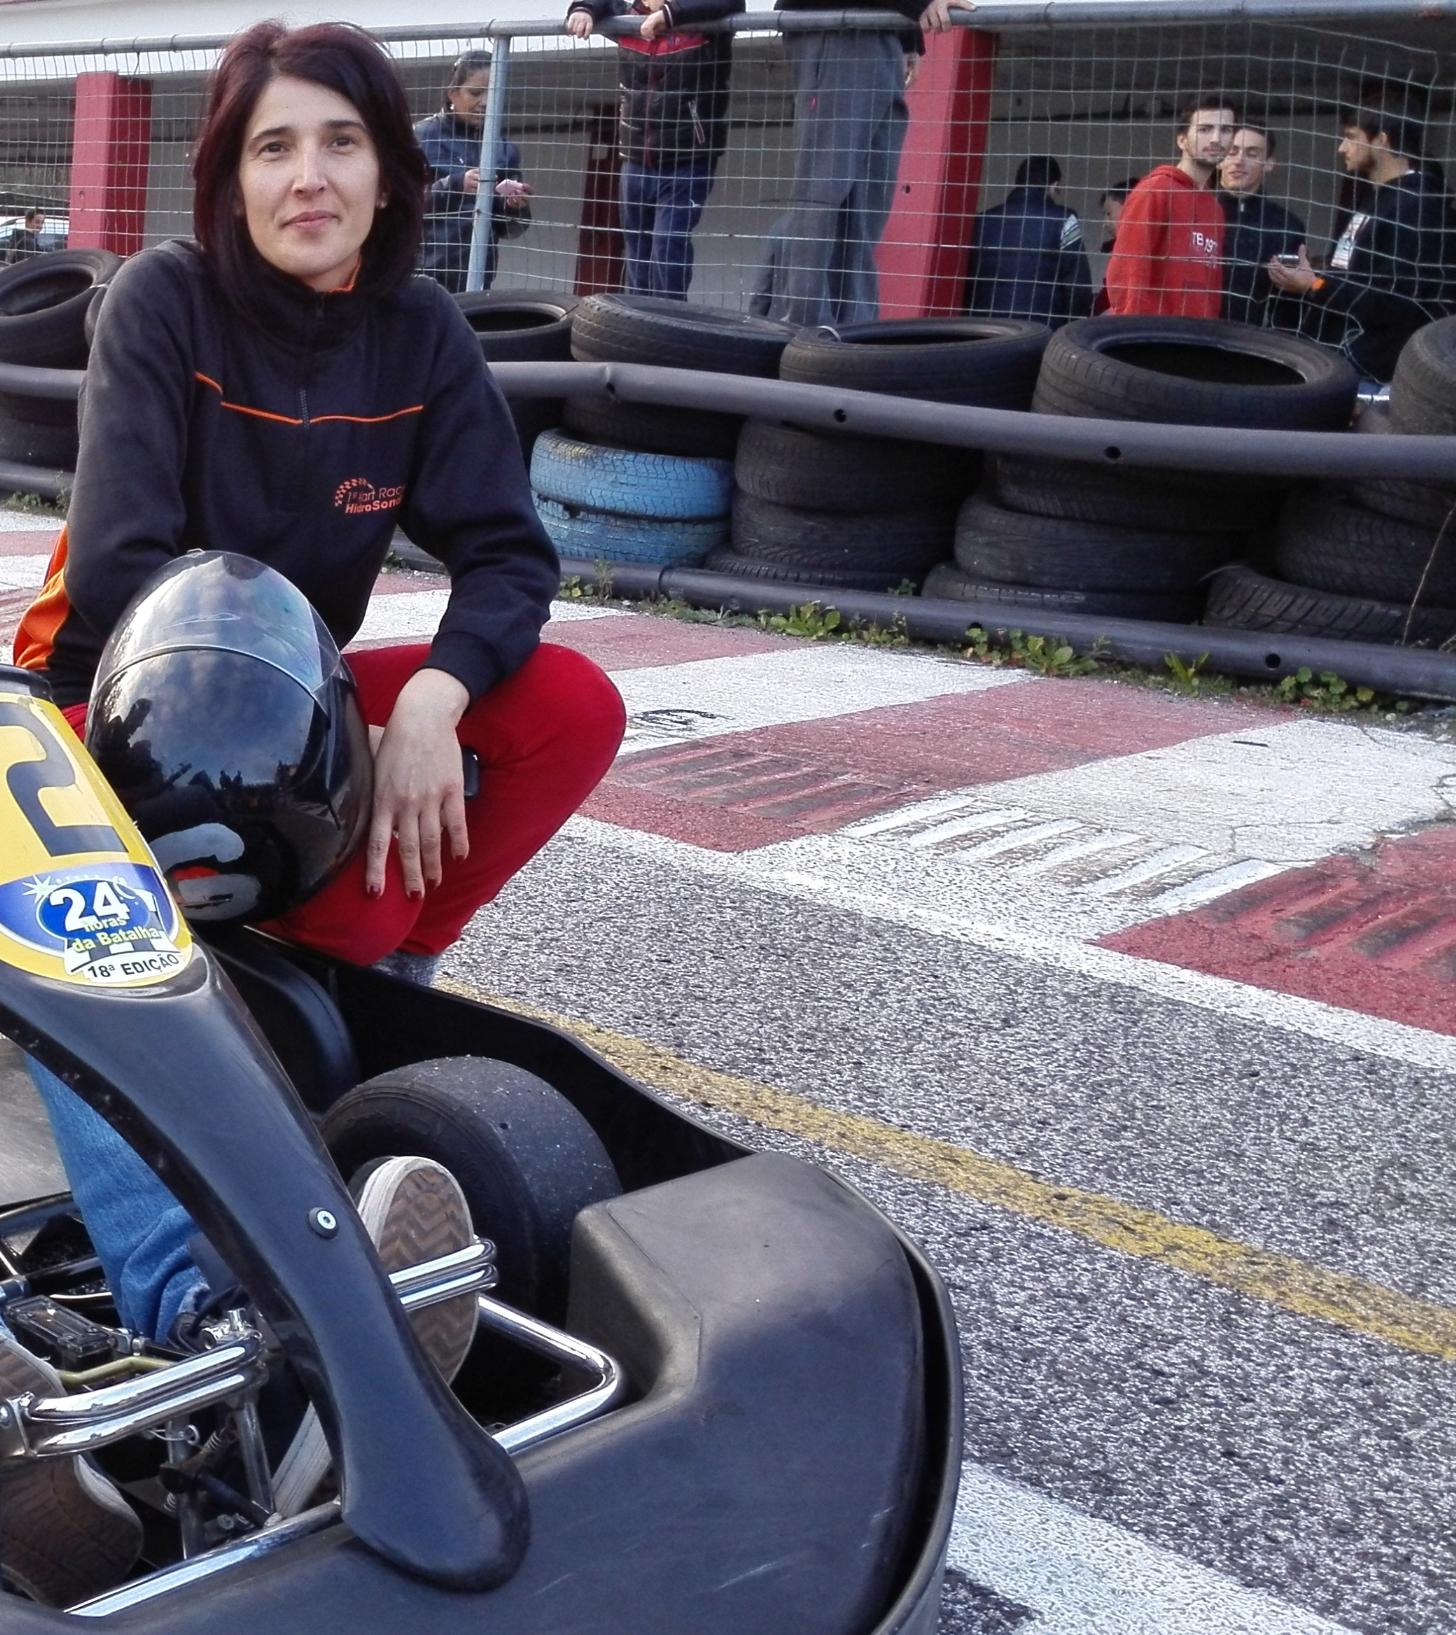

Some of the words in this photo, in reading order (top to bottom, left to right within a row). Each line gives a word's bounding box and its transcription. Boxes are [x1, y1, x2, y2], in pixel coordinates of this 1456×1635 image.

[49, 881, 130, 932] 24
[71, 938, 96, 954] da
[96, 925, 160, 946] Batalha
[87, 963, 116, 978] 18ª
[120, 953, 180, 975] EDIÇÃO
